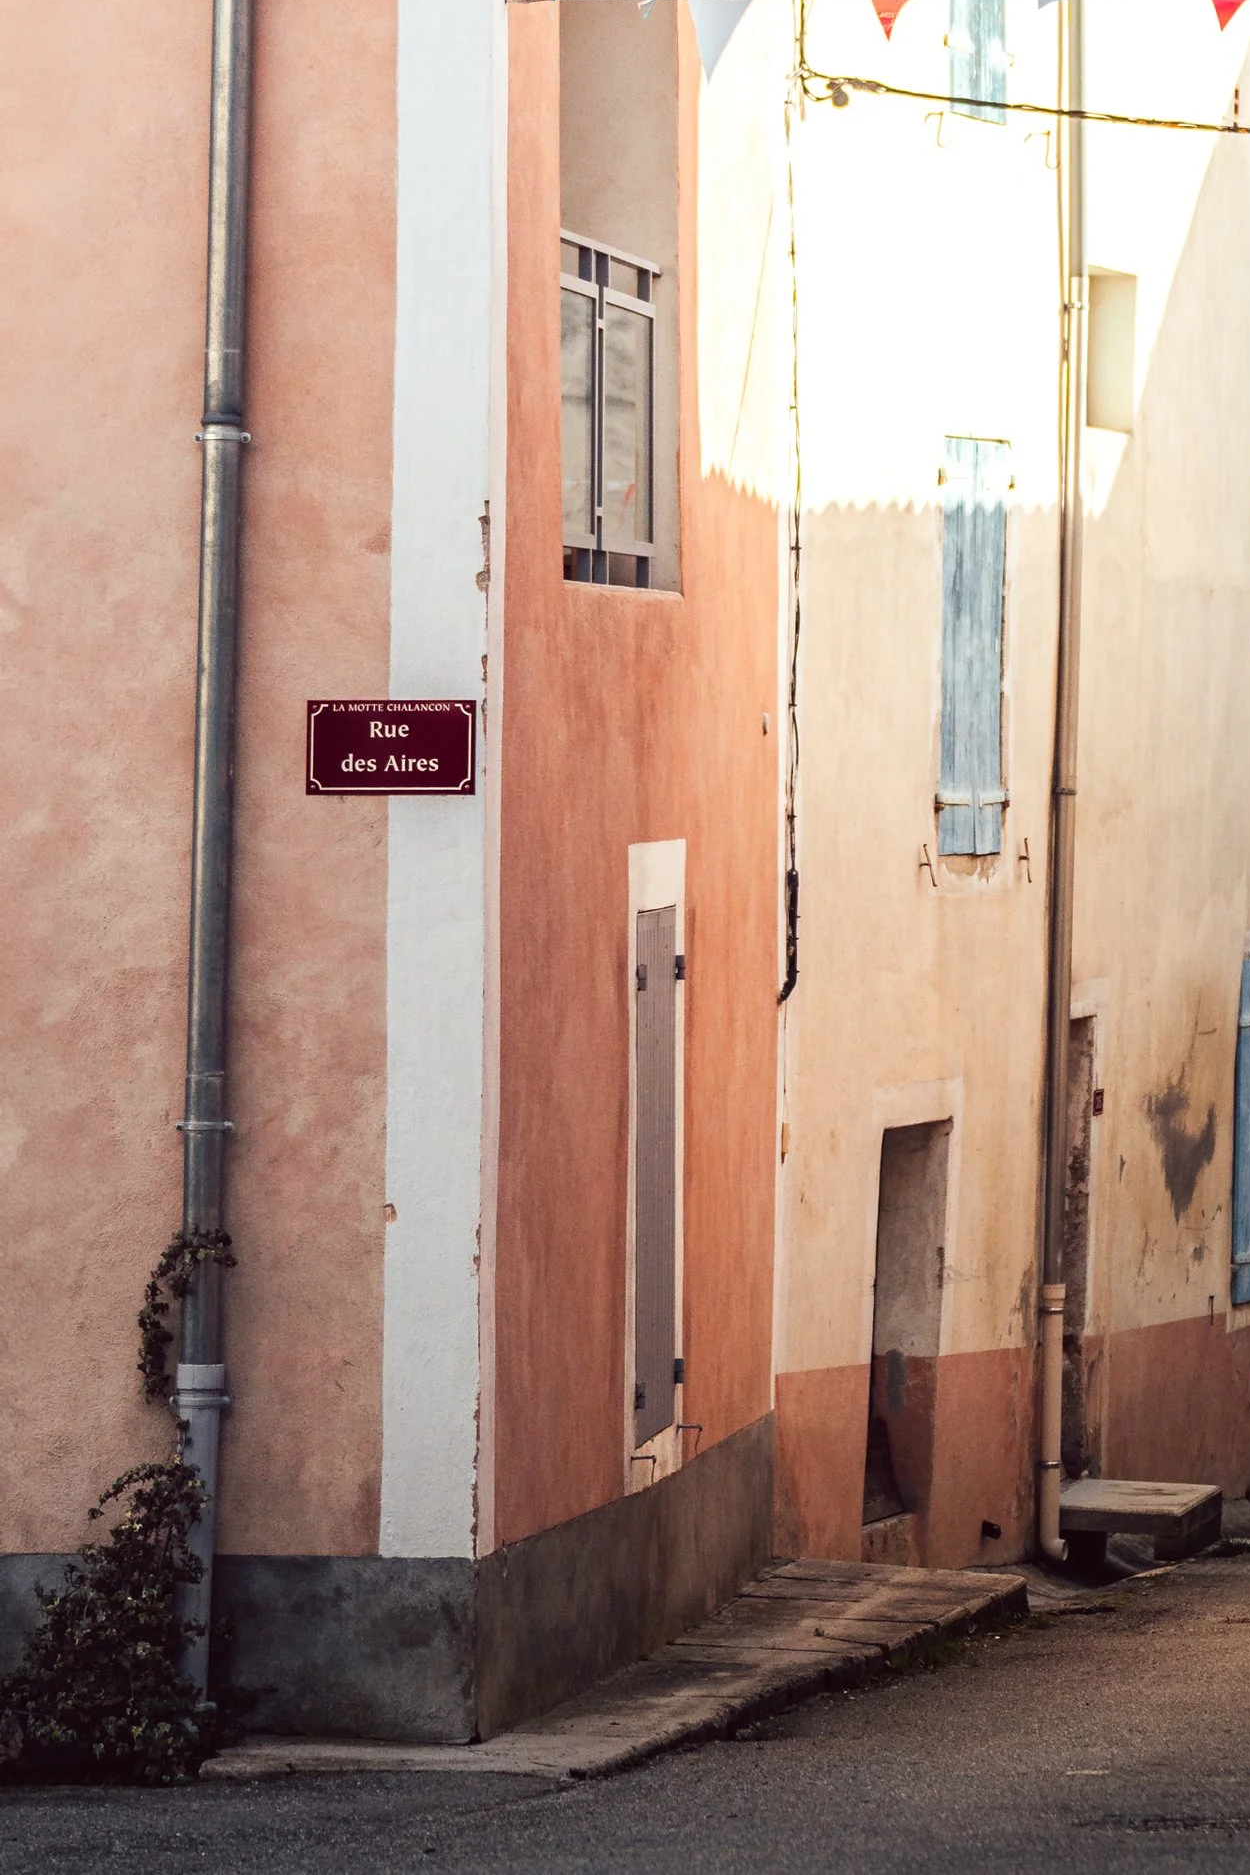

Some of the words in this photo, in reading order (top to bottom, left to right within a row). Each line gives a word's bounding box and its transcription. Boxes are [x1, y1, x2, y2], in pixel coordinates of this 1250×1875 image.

[332, 703, 346, 712] LA
[348, 703, 385, 712] MOTTE
[386, 703, 451, 712] CHALANCON
[369, 721, 410, 738] Rue
[341, 753, 378, 773] des
[384, 754, 440, 773] Aires
